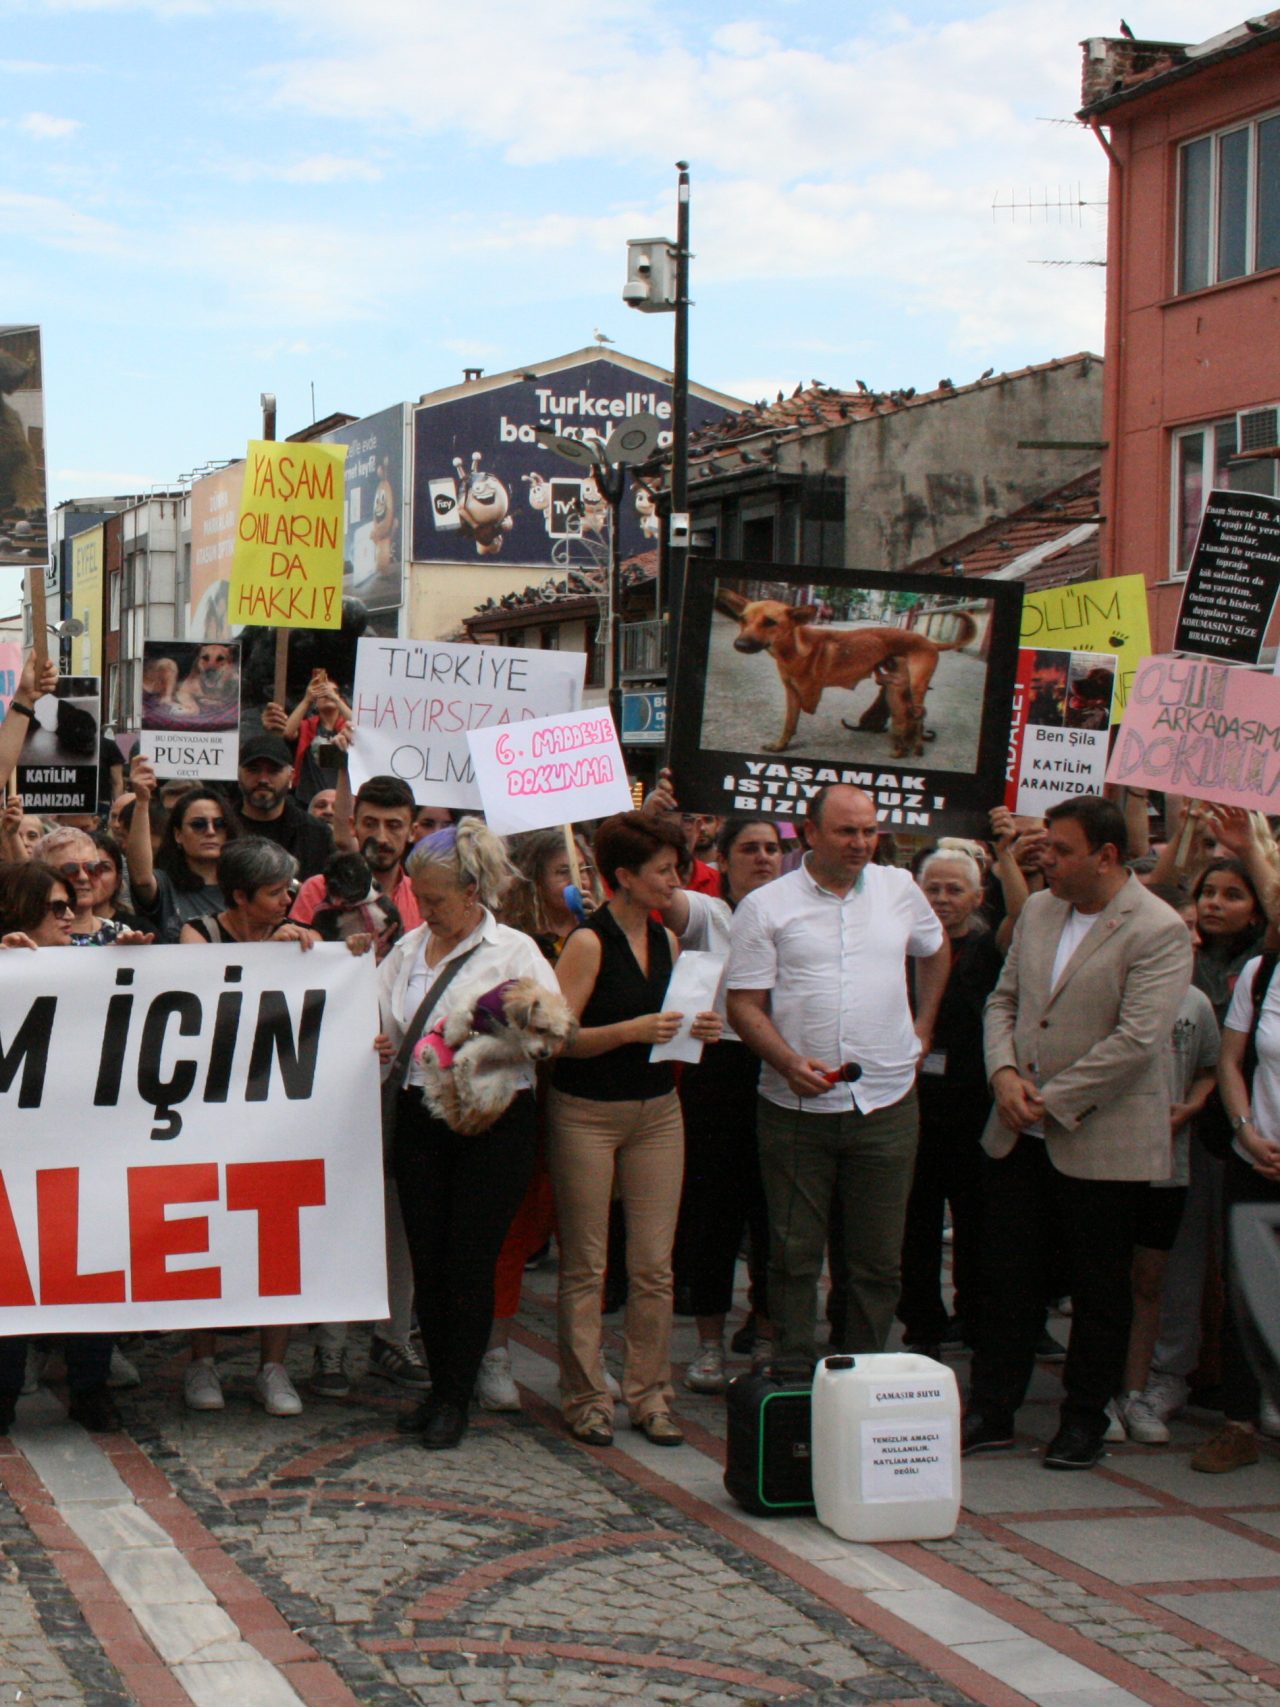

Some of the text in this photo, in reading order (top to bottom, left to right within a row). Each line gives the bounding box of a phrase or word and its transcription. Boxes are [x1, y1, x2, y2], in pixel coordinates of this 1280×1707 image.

[253, 453, 333, 502] YAŞAM
[1255, 511, 1270, 521] 38.
[239, 512, 338, 549] ONLARIN
[1244, 522, 1256, 531] ile
[1258, 526, 1280, 536] yere
[1231, 546, 1243, 555] ile
[270, 552, 308, 581] DA
[1252, 576, 1264, 585] da
[239, 583, 336, 622] HAKKI!
[1216, 596, 1226, 605] da
[1230, 613, 1248, 622] var.
[378, 647, 529, 692] TÜRKİYE
[357, 693, 549, 733] HAYIRSIZAD
[167, 735, 208, 743] DÜNYADAN
[496, 719, 614, 765] 6. MADDEYE
[1036, 729, 1096, 747] Ben Şila
[154, 746, 224, 766] PUSAT
[390, 745, 475, 783] OLM
[26, 767, 77, 783] KATİLİM
[507, 755, 614, 796] DOKUNMA
[744, 761, 926, 791] YAŞAMAK
[1032, 759, 1092, 775] KATİLİM
[18, 793, 85, 807] ARANIZDA!
[733, 795, 807, 815] BİZİ
[93, 964, 327, 1141] İÇİN
[876, 1390, 940, 1402] ÇAMAŞIR SUYU
[910, 1434, 939, 1442] AMAÇLI
[910, 1456, 939, 1464] AMAÇLI
